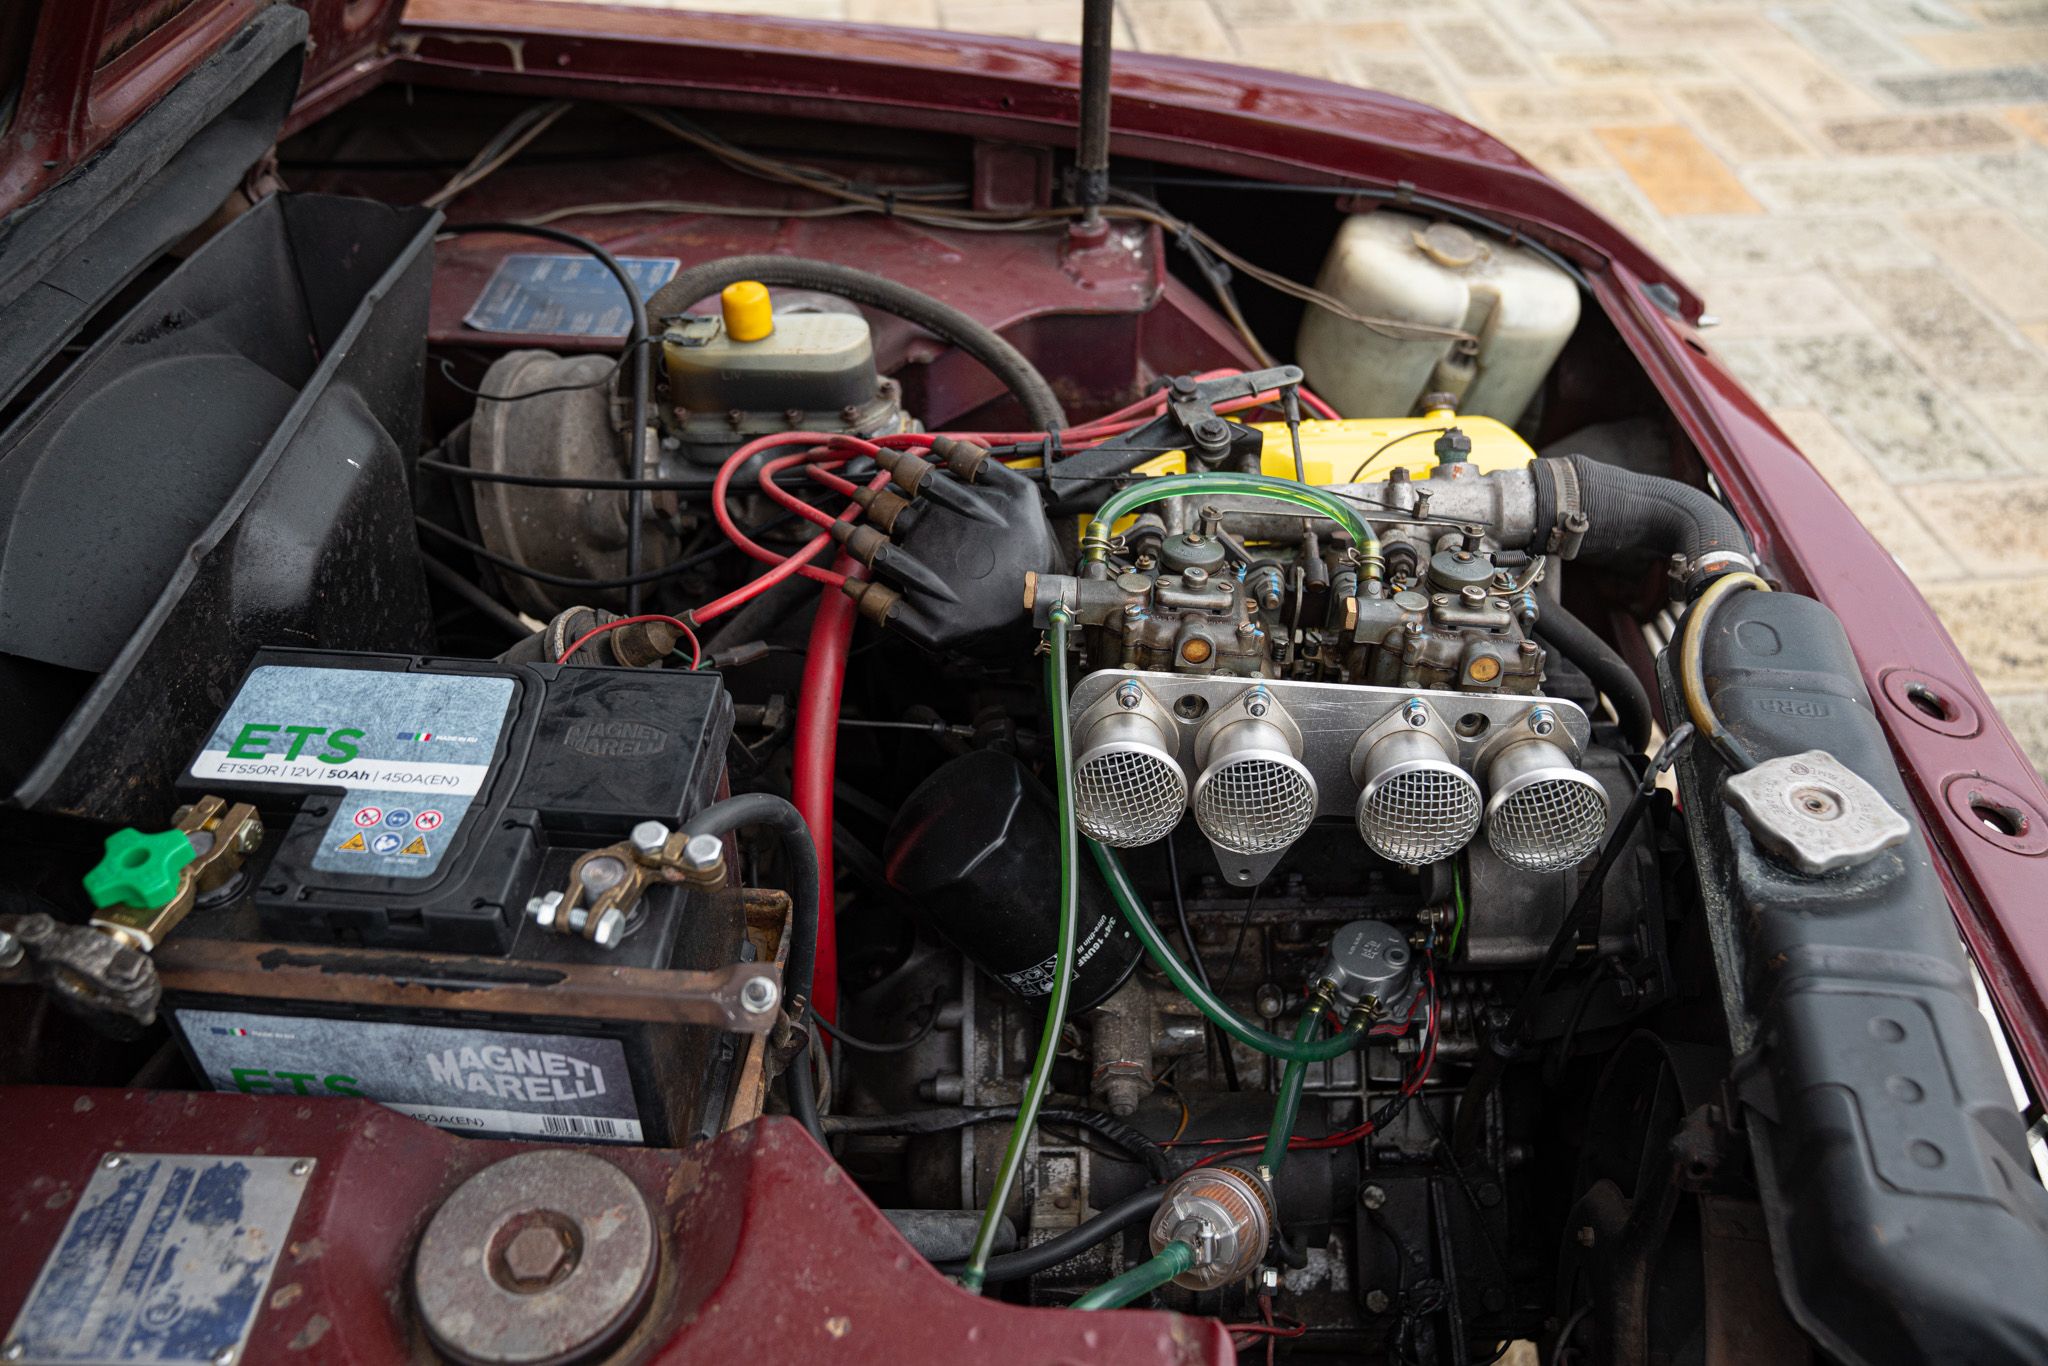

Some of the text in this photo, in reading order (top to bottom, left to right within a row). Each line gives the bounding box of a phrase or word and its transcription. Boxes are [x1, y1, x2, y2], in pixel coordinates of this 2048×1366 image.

[226, 723, 366, 764] ETS
[217, 762, 279, 775] ETS50R
[290, 766, 317, 777] 12V
[326, 769, 370, 781] 50Ah
[382, 772, 460, 787] 450A(EN)
[1077, 938, 1104, 967] 16UNF
[427, 1046, 606, 1089] MAGNETI
